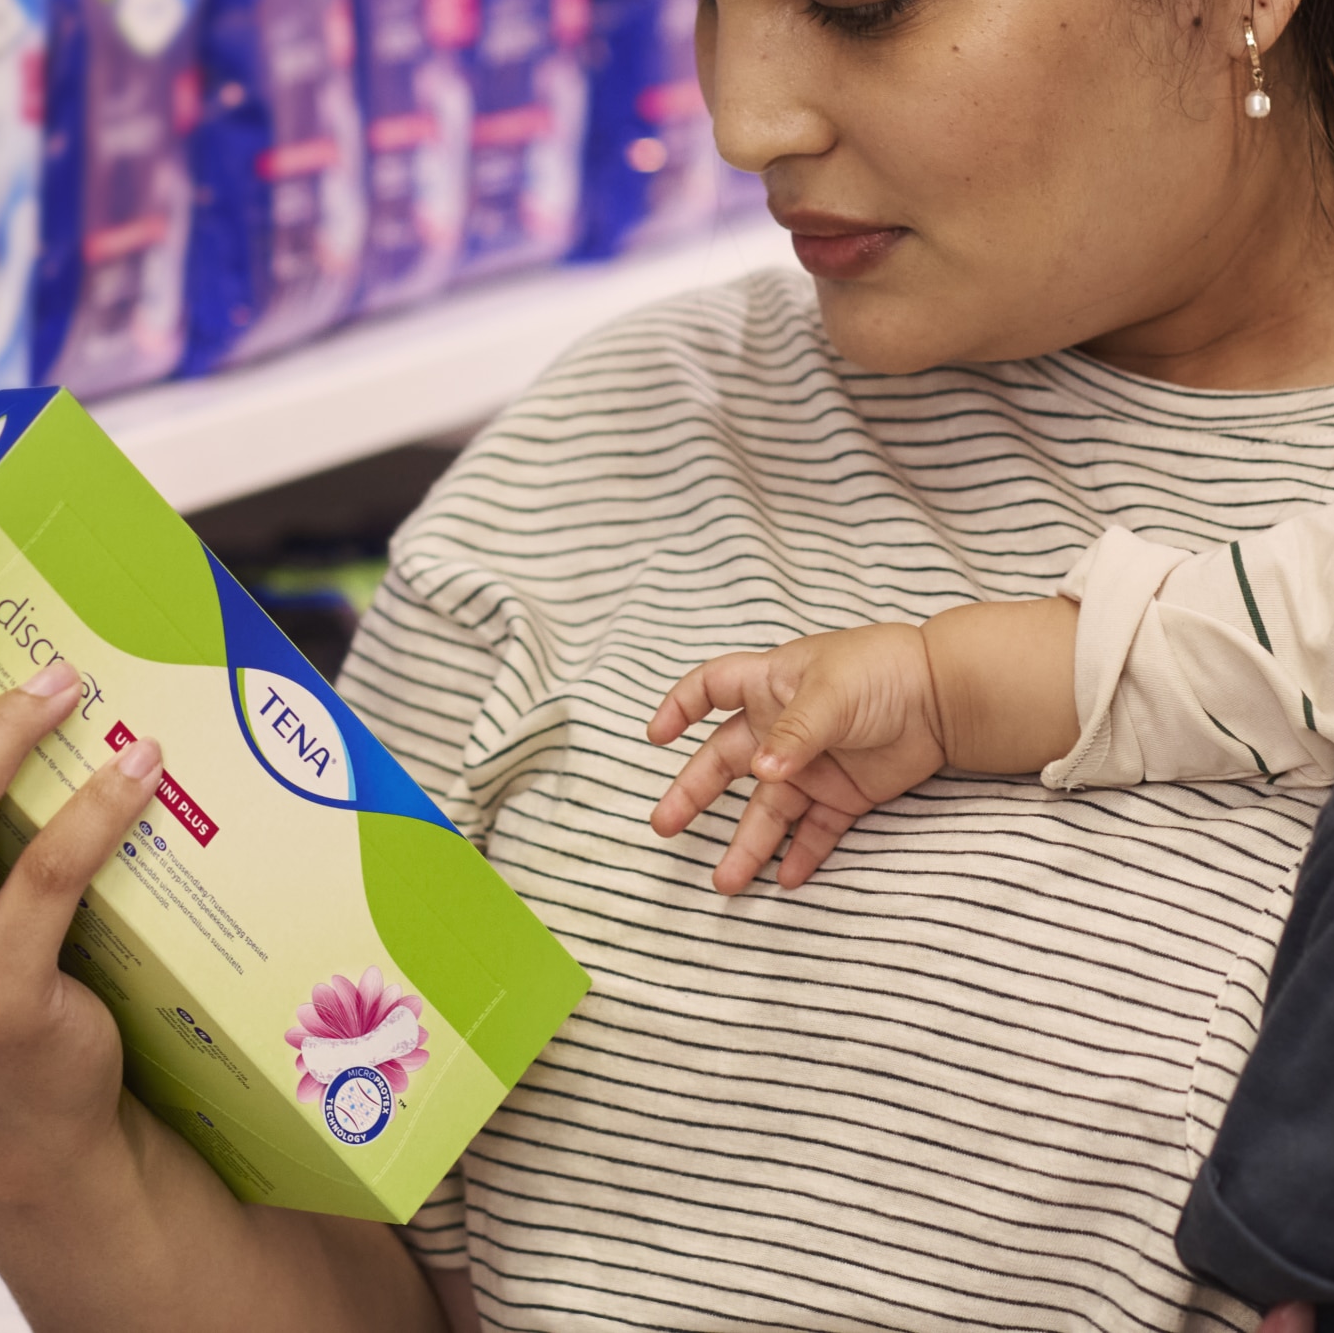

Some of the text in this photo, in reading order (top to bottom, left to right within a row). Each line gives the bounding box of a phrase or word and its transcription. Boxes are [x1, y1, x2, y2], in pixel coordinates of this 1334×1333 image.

[260, 686, 331, 778] TENA
[74, 749, 84, 761] for
[178, 801, 209, 836] PLUS
[132, 829, 161, 860] utformet
[159, 858, 168, 869] til
[166, 866, 192, 894] dryp/for
[210, 938, 245, 976] suunniteltu
[245, 936, 269, 962] spesielt
[347, 1068, 389, 1115] MICROPROTEX
[326, 1097, 367, 1143] TECHNOLOGY
